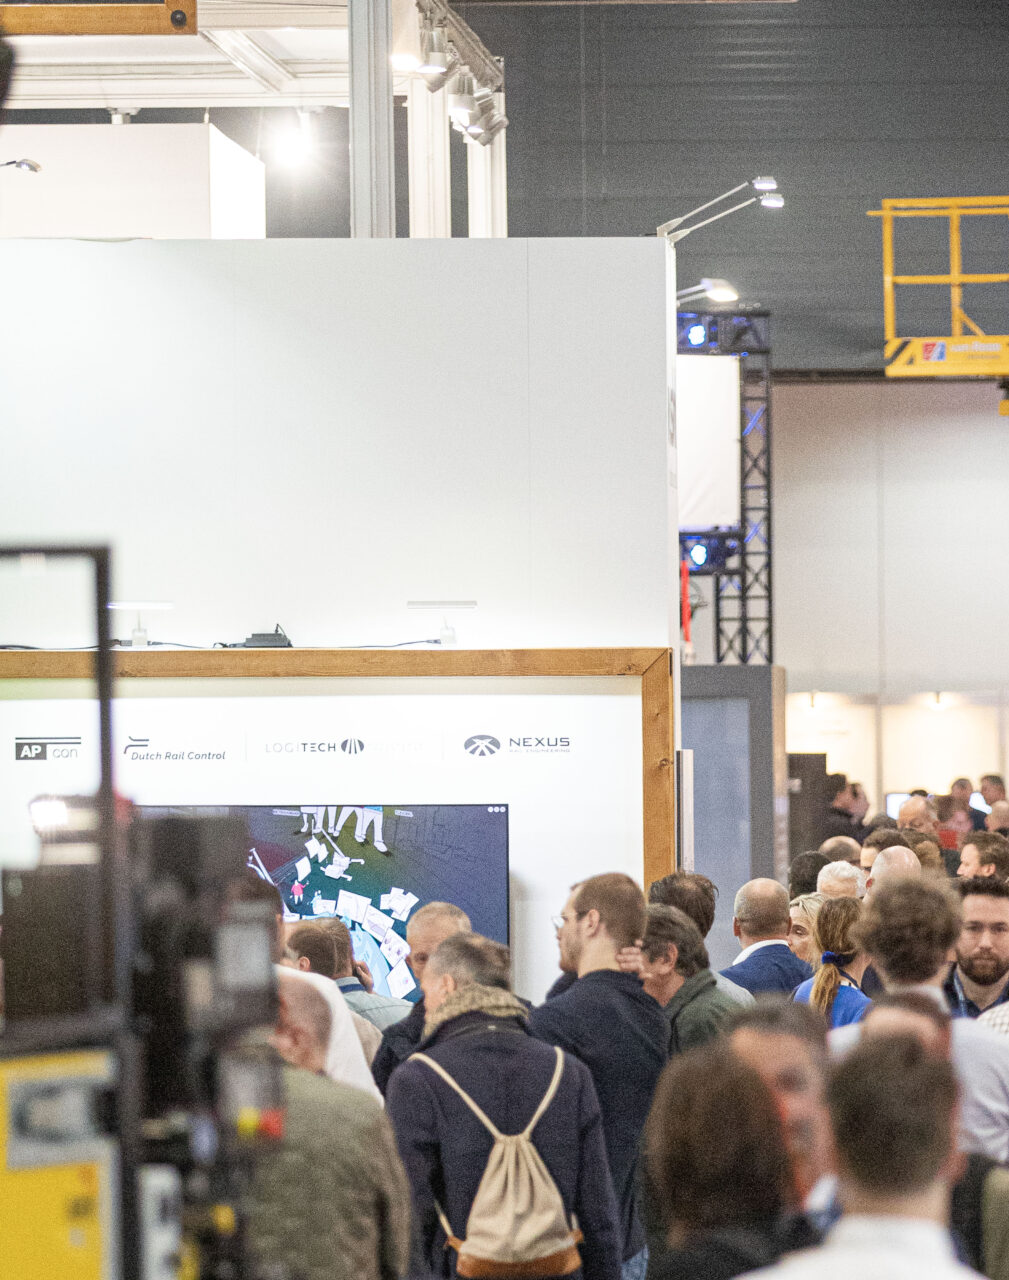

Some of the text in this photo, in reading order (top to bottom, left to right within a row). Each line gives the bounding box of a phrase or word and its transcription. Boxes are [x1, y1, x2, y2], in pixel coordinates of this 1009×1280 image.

[509, 737, 571, 747] NEXUS
[131, 751, 226, 761] Dutch Rail Control
